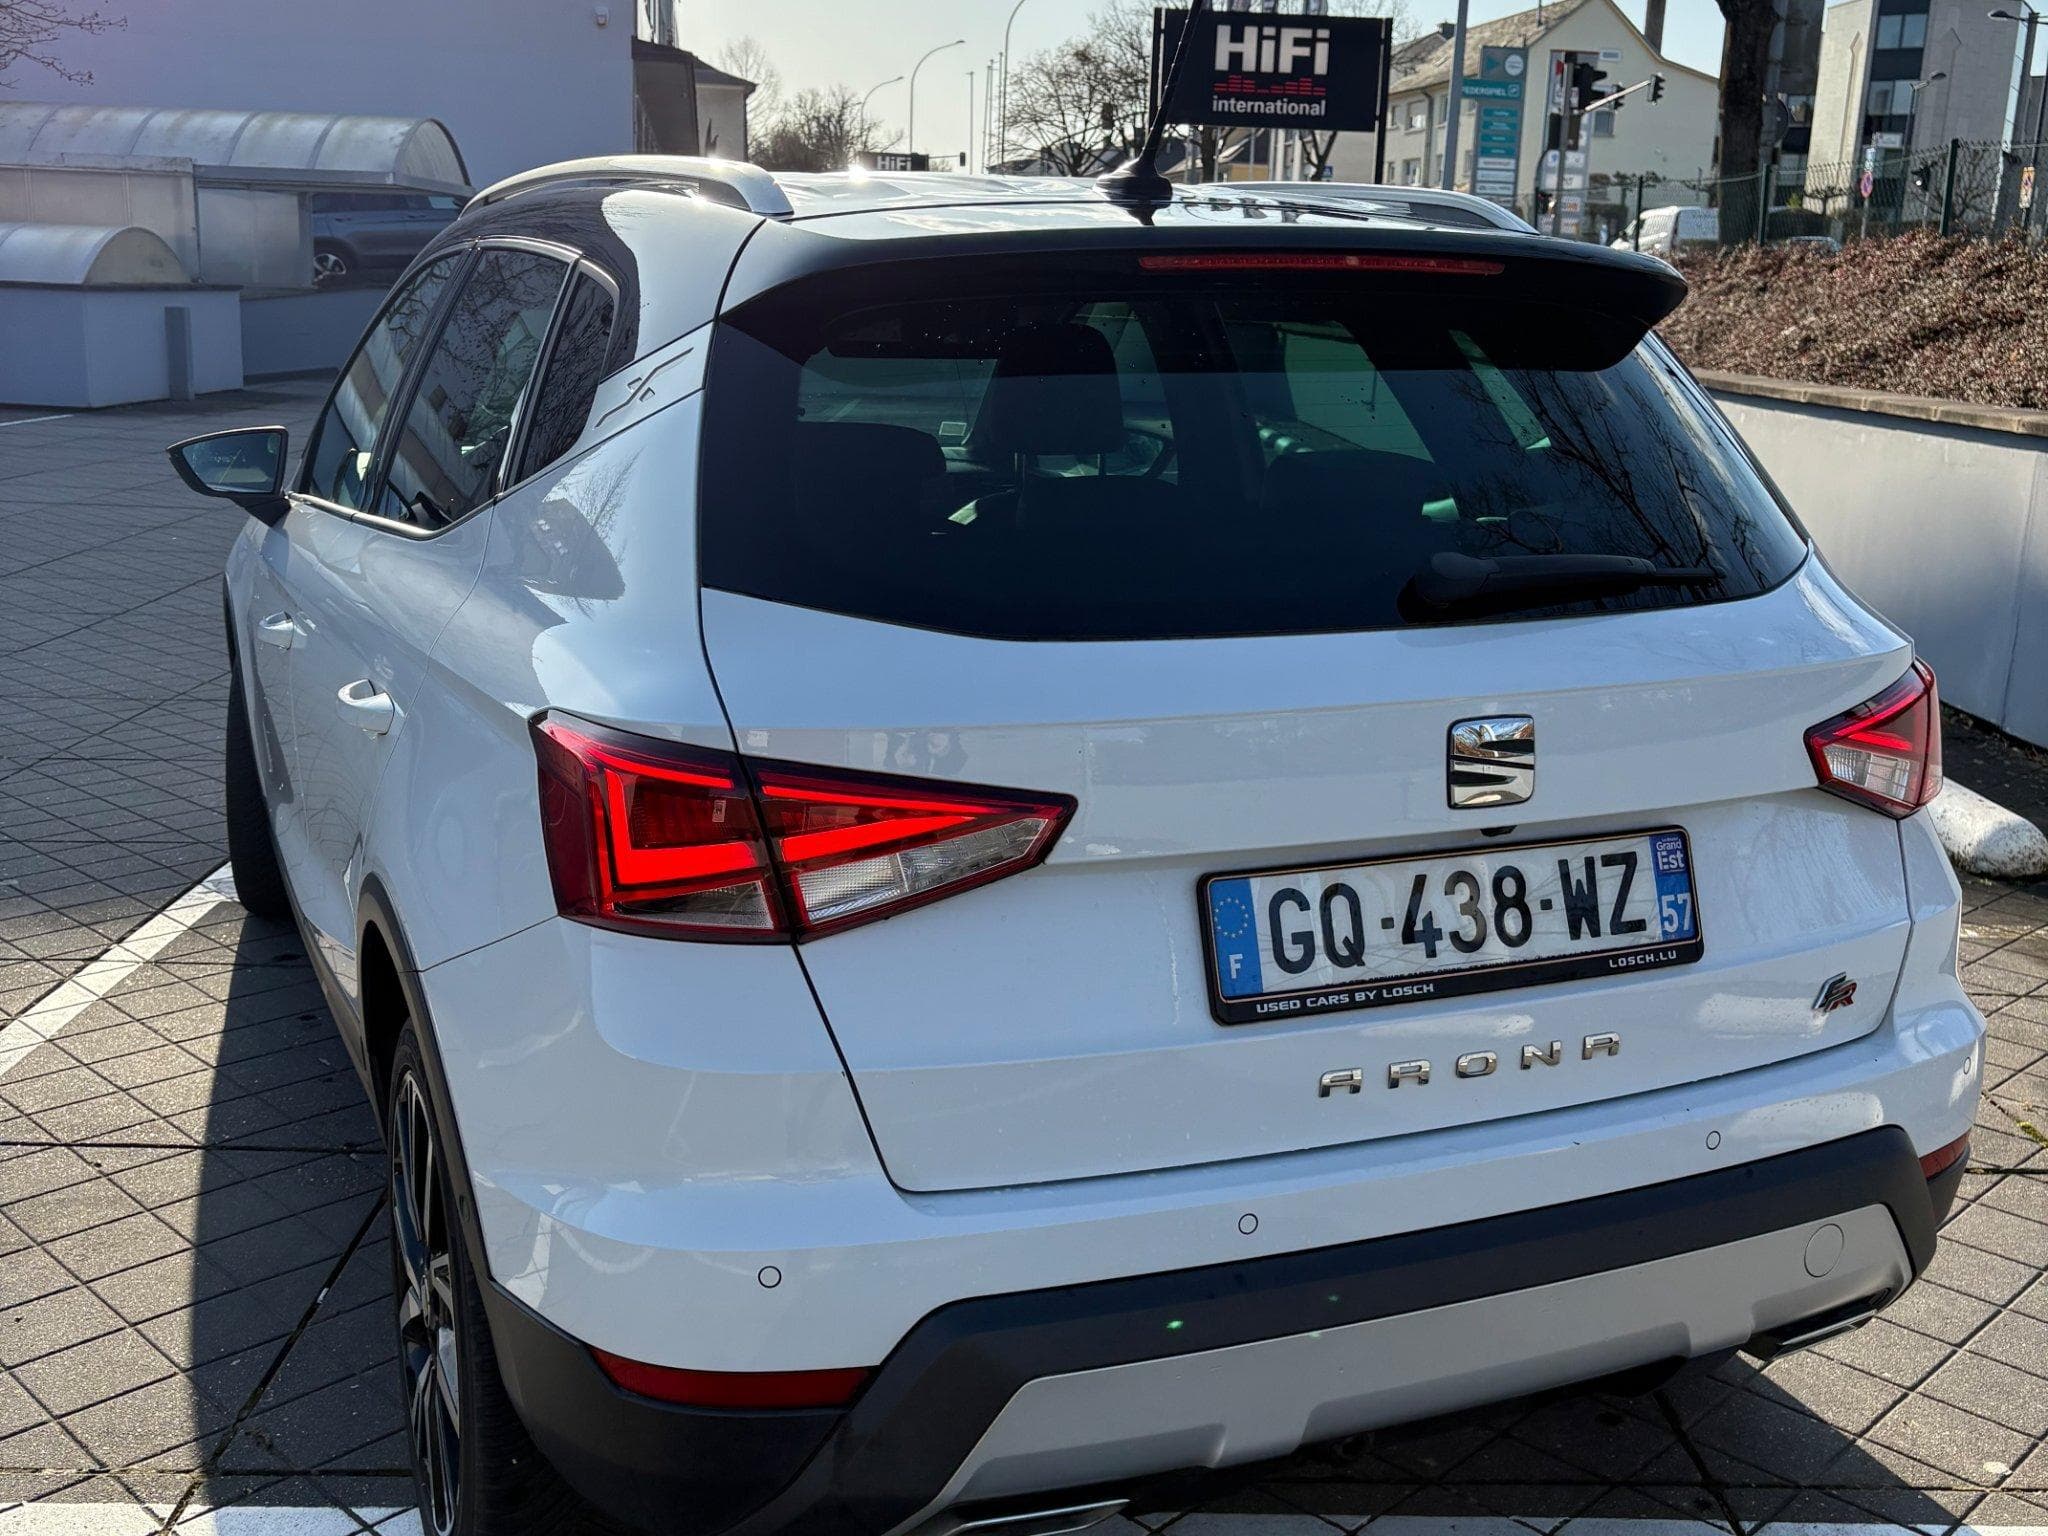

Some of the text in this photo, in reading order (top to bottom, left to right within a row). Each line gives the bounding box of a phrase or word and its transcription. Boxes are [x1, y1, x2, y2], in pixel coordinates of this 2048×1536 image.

[1214, 24, 1331, 76] HiFi
[1212, 95, 1326, 117] international
[877, 155, 912, 170] HiFi
[1656, 838, 1682, 851] Grand
[1657, 849, 1685, 870] Est
[1661, 892, 1692, 933] 57
[1229, 953, 1243, 979] F
[1609, 950, 1677, 968] LOSCH.LU
[1256, 983, 1434, 1013] USED CARS BY LOSCH
[1319, 1030, 1621, 1098] ARONA
